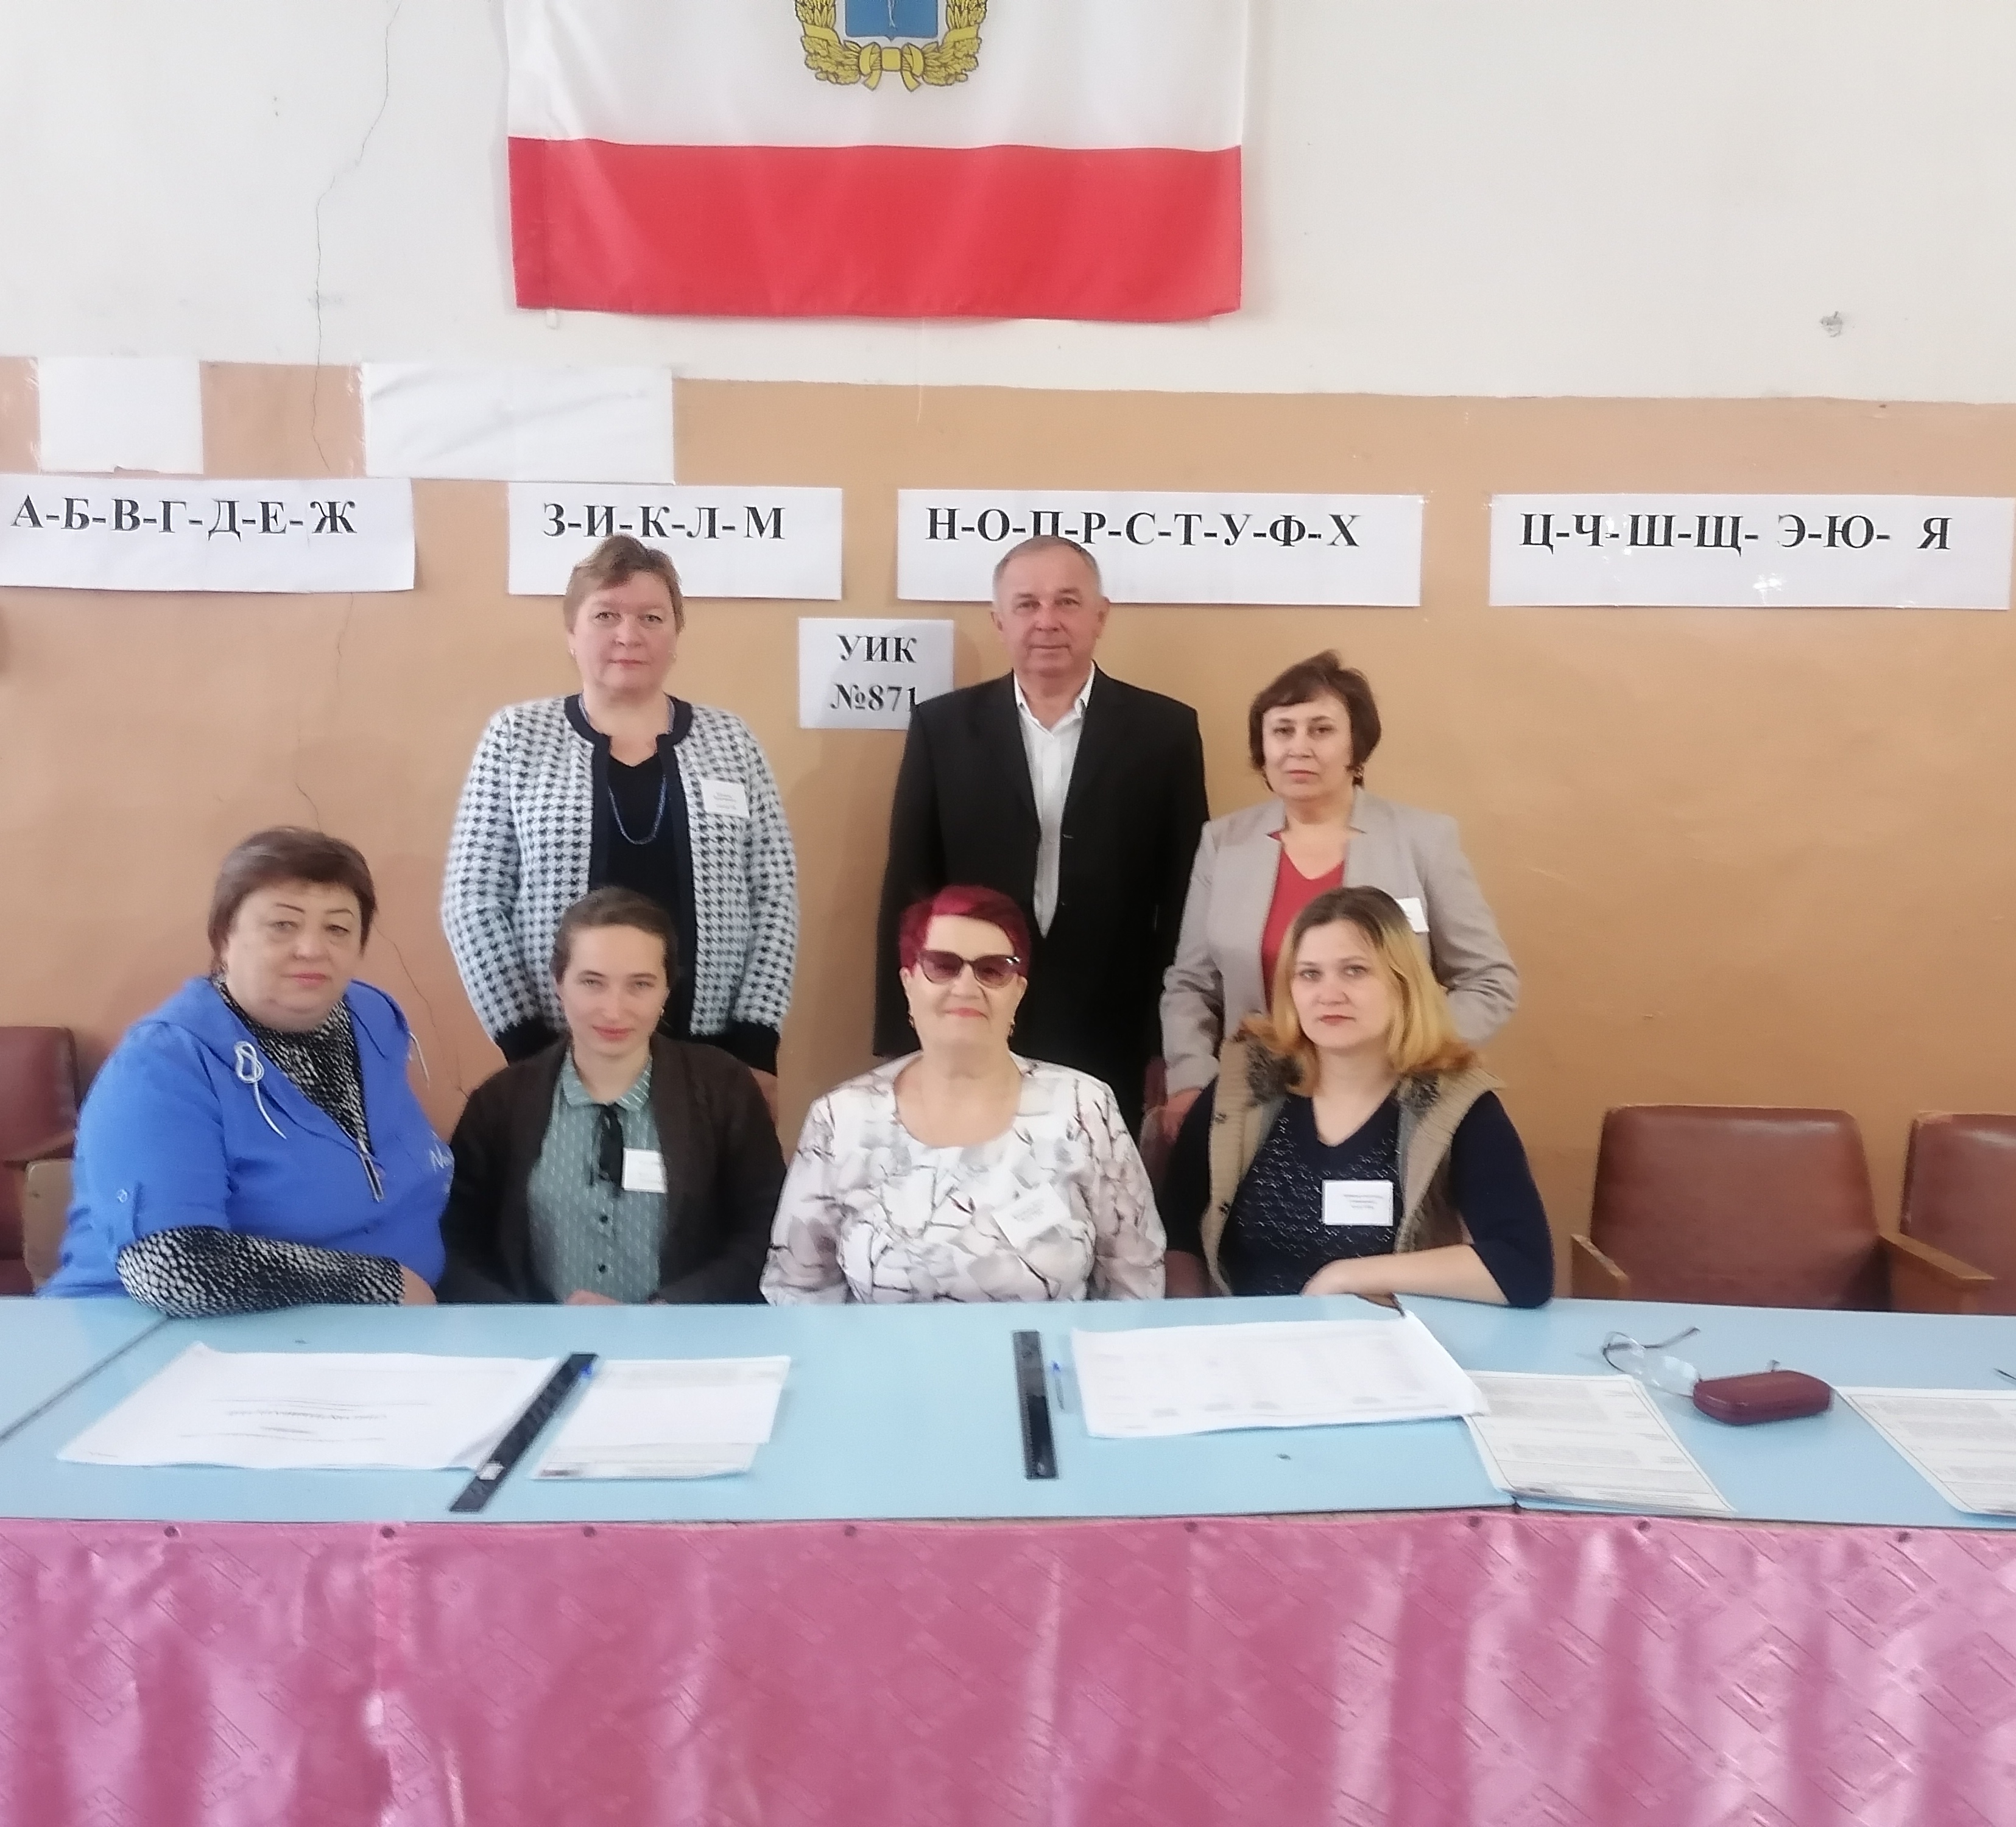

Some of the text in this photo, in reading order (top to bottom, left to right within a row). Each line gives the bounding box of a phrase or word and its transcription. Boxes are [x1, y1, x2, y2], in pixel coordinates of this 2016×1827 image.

[9, 494, 358, 541] А-Б-В-Г-Д-Е-Ж
[543, 502, 786, 540] З-И-К-Л-М
[925, 507, 1361, 547] Н-О-П-Р-С-Т-У-Ф-Х
[836, 633, 917, 663] УИК
[830, 682, 916, 711] №871
